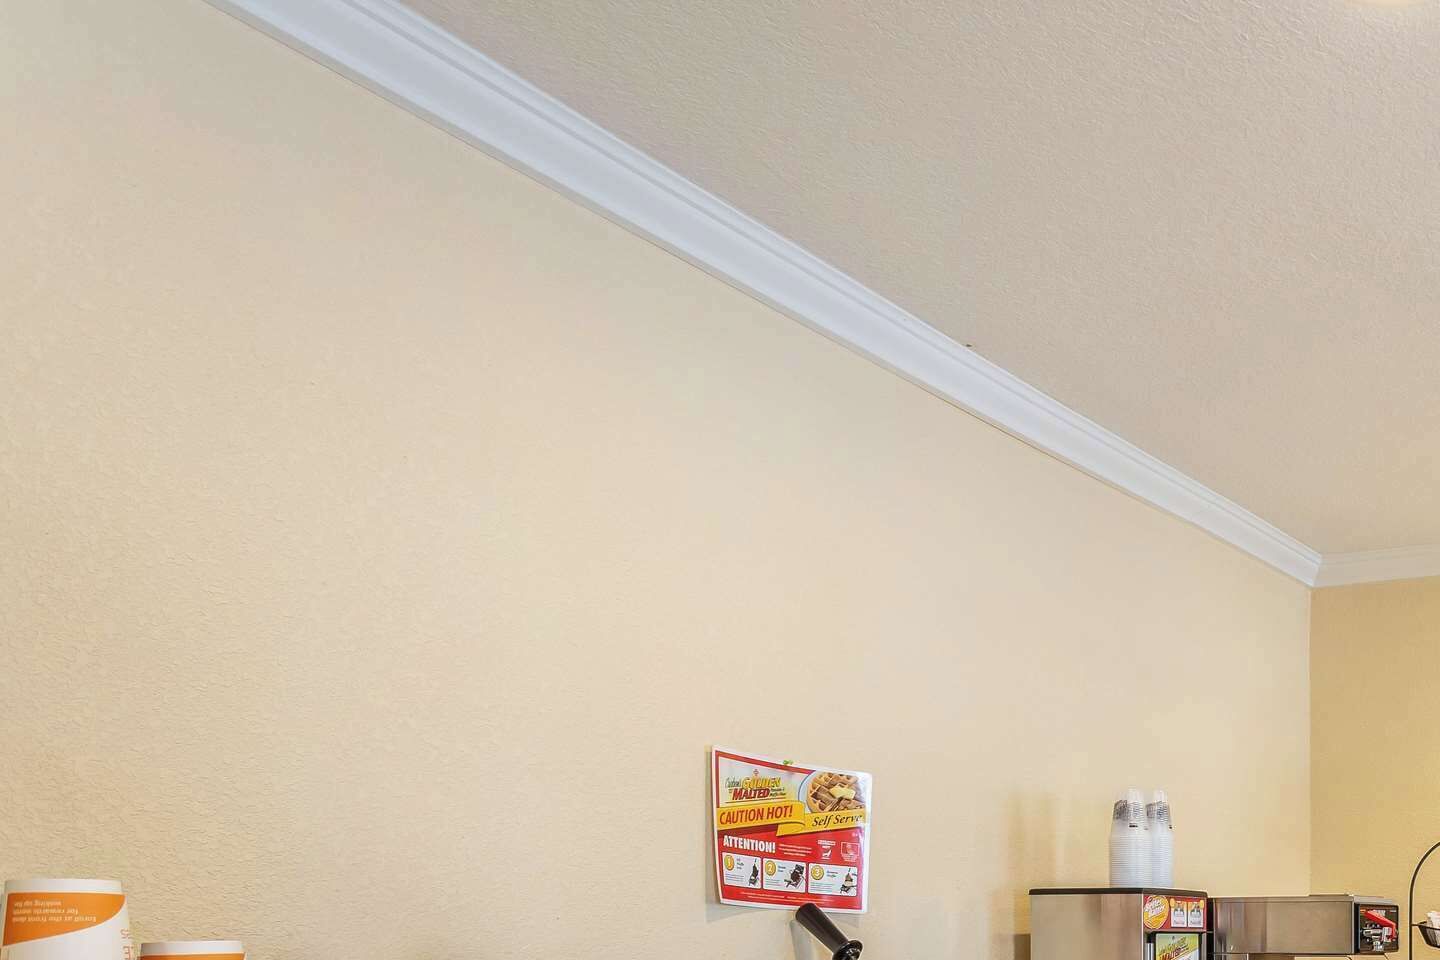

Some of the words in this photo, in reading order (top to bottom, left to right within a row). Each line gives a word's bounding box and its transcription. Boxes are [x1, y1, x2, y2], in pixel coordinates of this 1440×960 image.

[732, 788, 771, 801] MALTED
[719, 809, 764, 825] CAUTION
[767, 805, 793, 821] HOT!
[812, 816, 832, 829] Self
[834, 813, 862, 825] Serve
[723, 834, 776, 853] ATTENTION!
